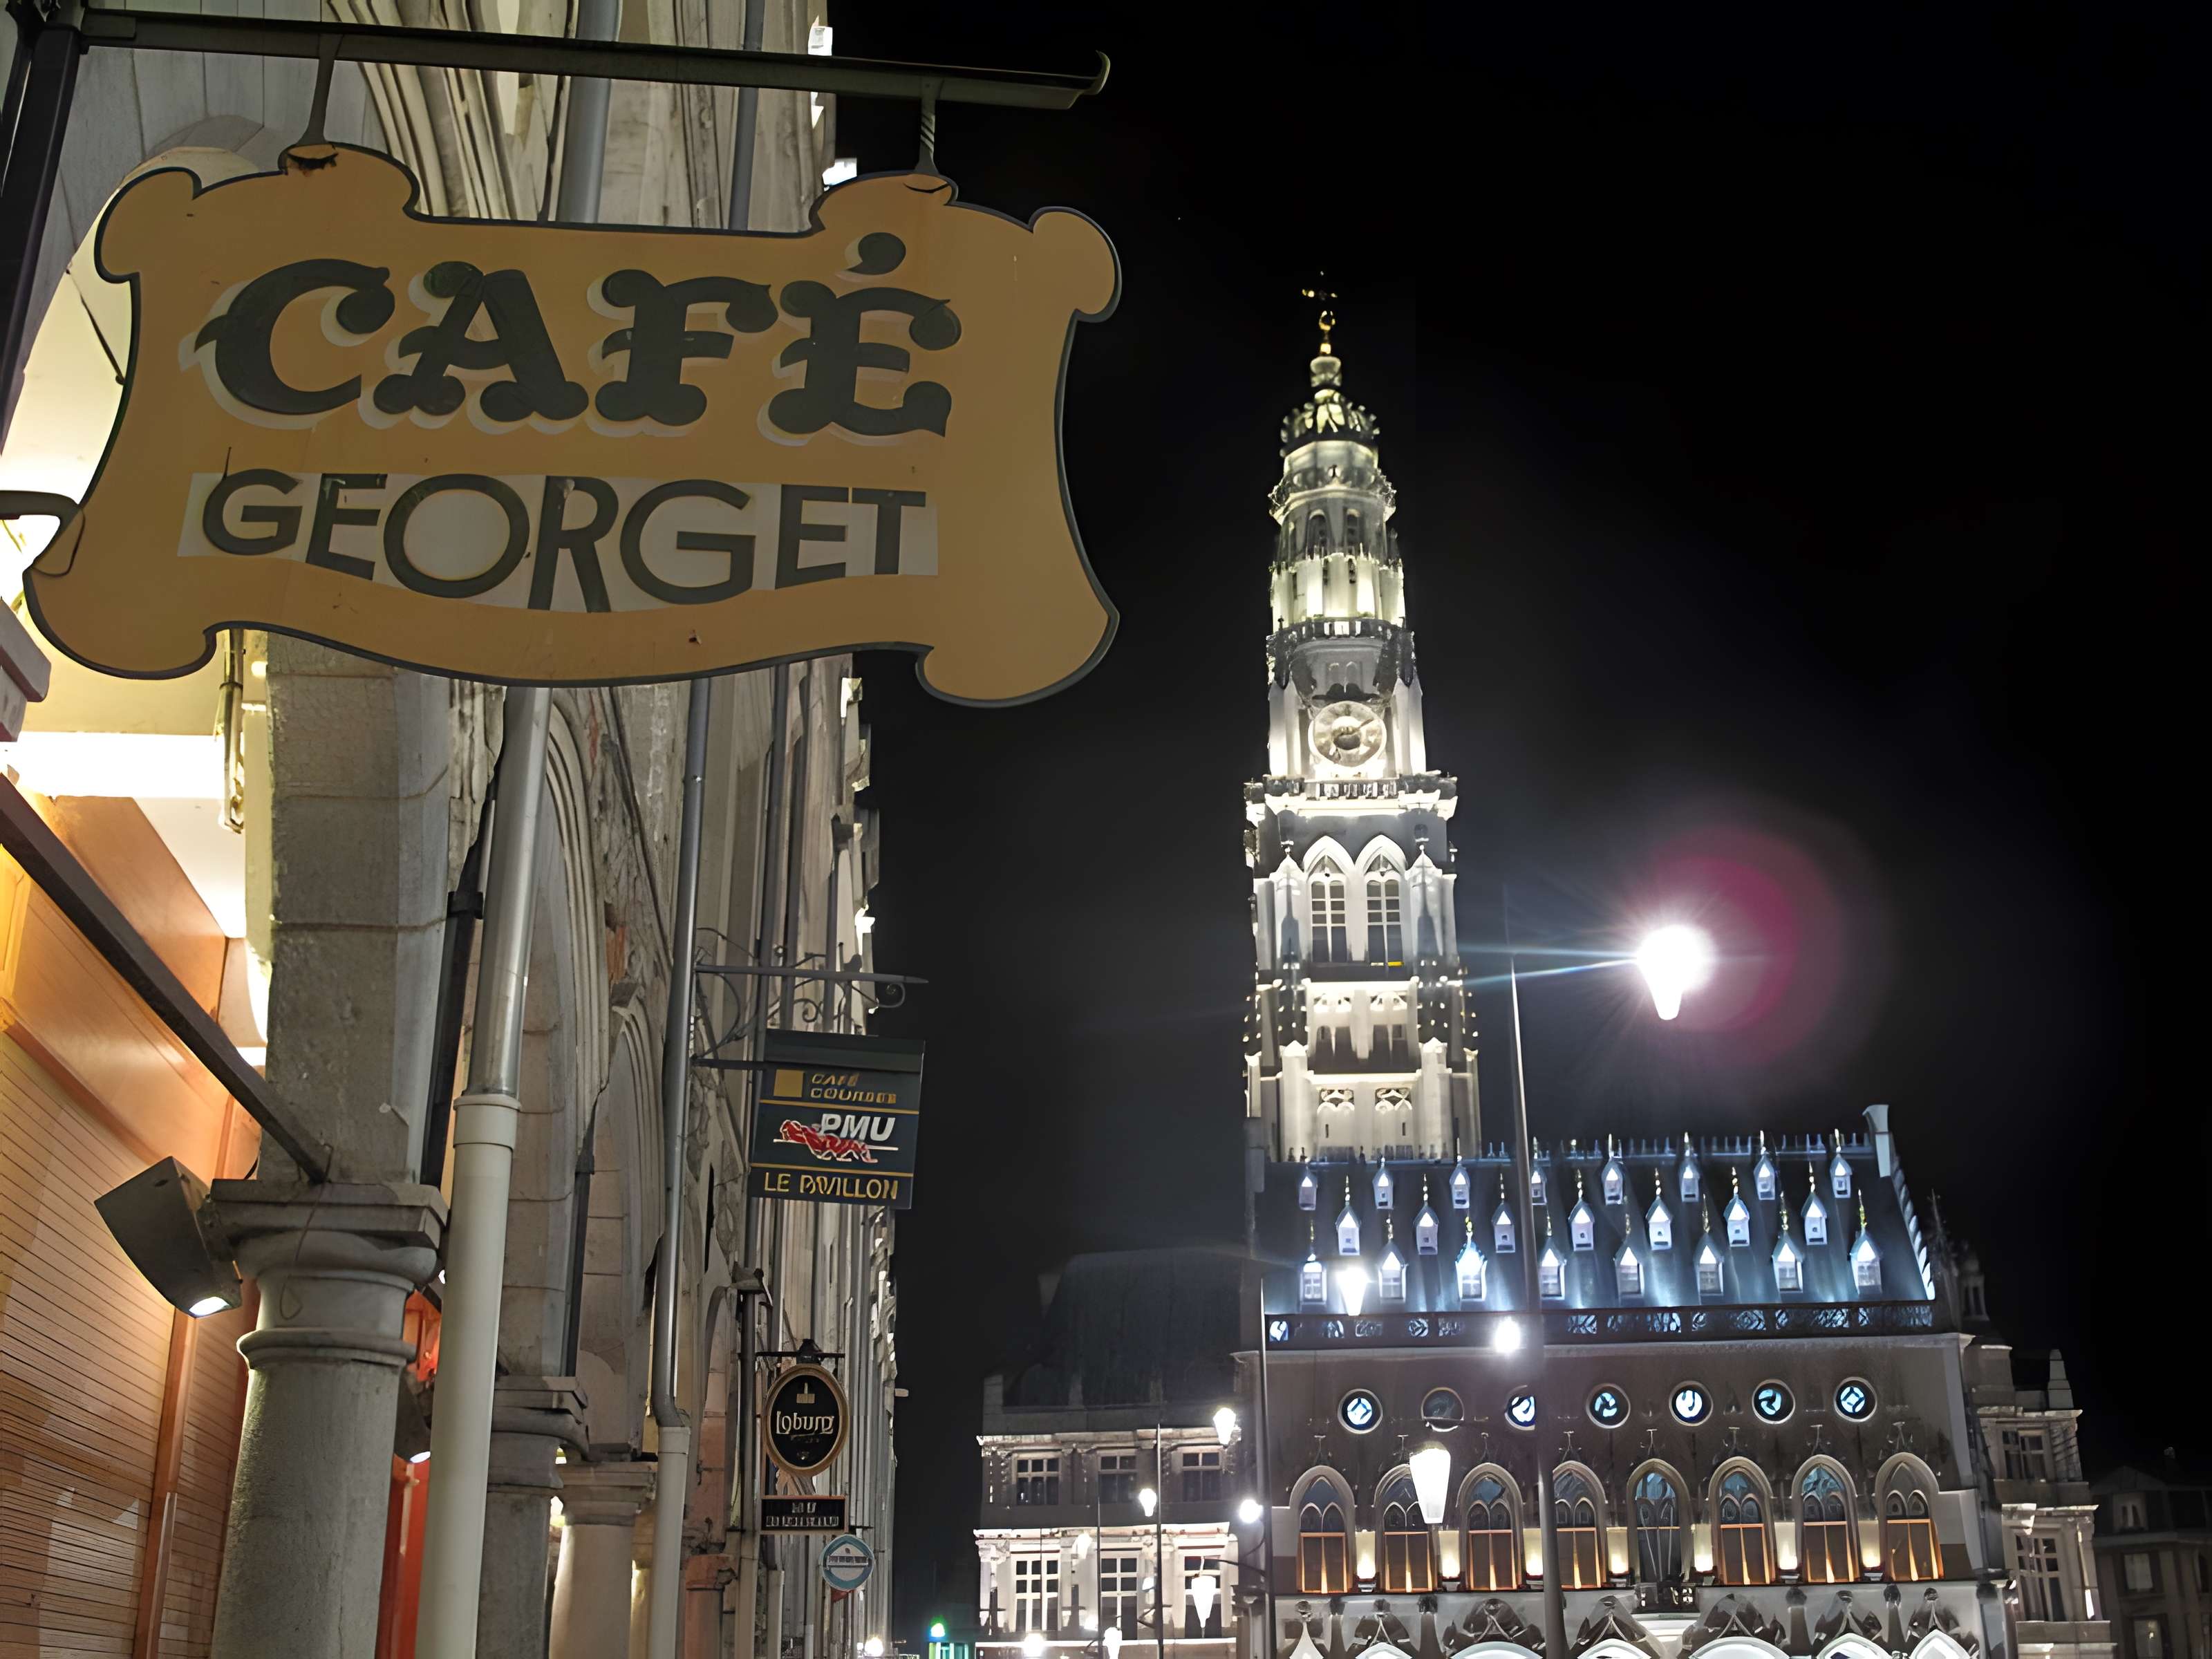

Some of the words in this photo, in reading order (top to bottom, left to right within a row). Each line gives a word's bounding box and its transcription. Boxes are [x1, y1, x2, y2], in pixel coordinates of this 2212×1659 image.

[188, 232, 963, 444] CAFÉ
[202, 469, 926, 612] GEORGET
[821, 1113, 896, 1142] PMU
[764, 1172, 791, 1192] LE
